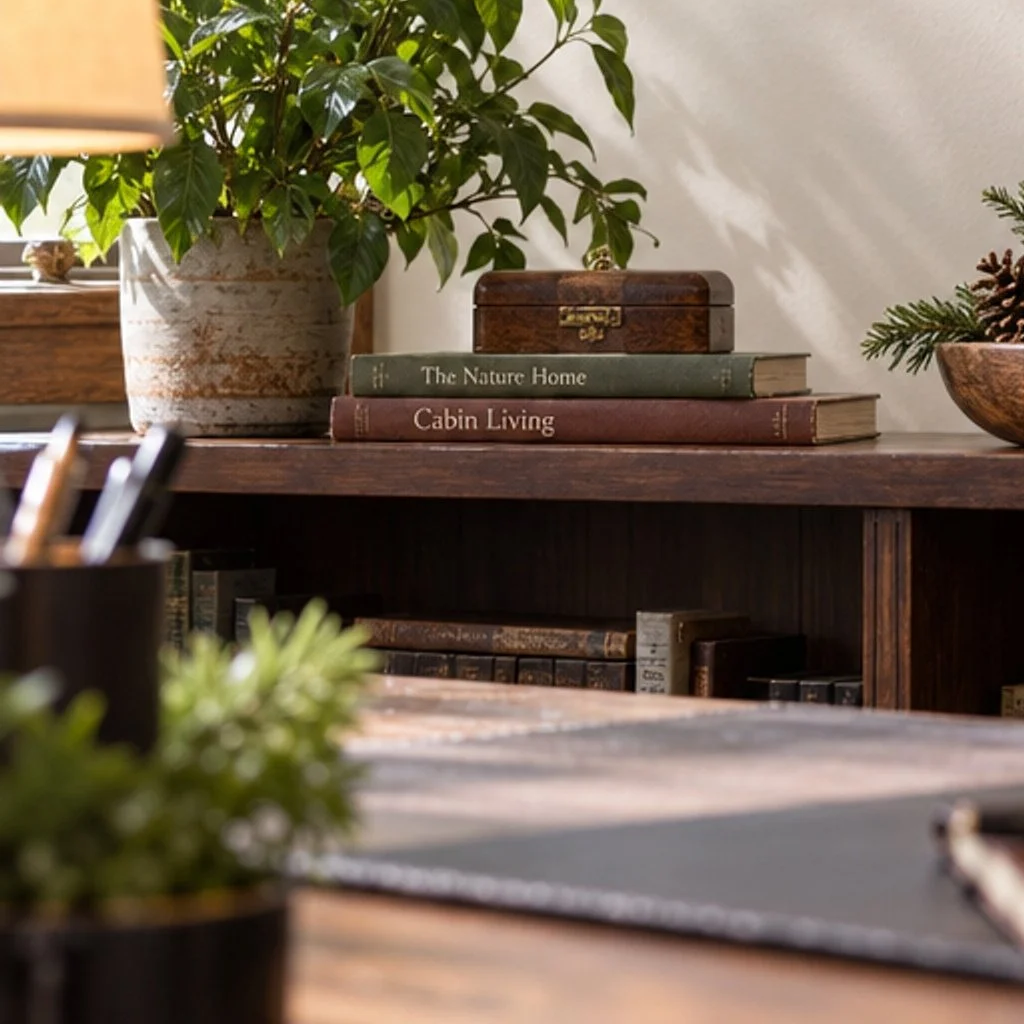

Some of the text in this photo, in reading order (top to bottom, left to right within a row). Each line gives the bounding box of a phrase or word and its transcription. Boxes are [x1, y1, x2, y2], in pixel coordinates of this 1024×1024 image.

[420, 365, 588, 387] The Nature Home
[412, 406, 556, 439] Cabin Living
